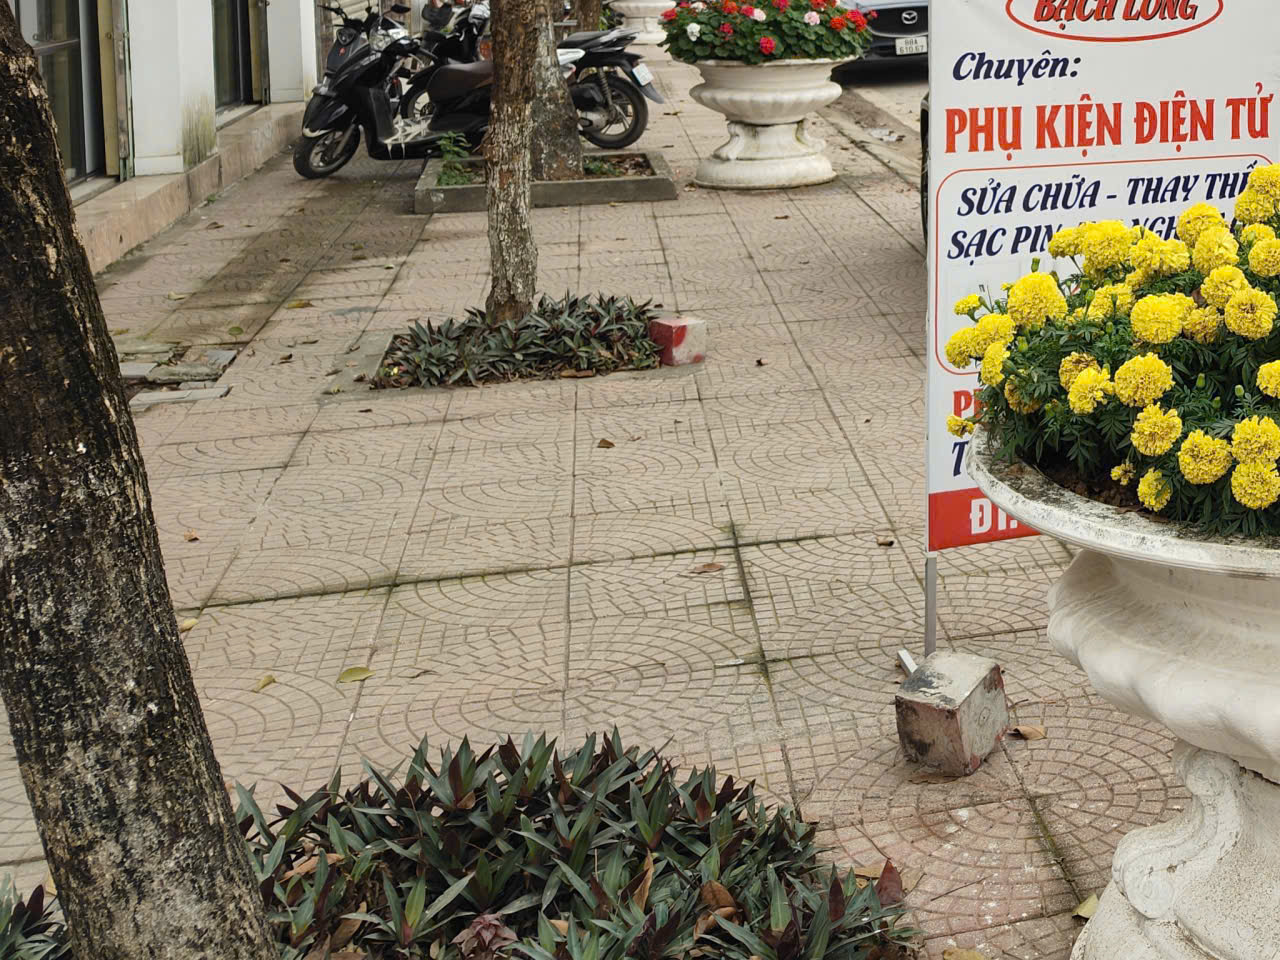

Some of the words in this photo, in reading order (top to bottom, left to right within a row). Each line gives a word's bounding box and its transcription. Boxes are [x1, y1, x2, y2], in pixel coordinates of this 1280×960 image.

[952, 50, 1082, 86] Chuyên:
[944, 106, 1023, 161] PHỤ
[1035, 93, 1122, 157] KIỆN
[1134, 89, 1215, 153] ĐIỆN
[1226, 82, 1275, 140] TỬ
[957, 177, 1017, 218] SỬA
[1021, 173, 1099, 212] CHỮA
[1127, 175, 1200, 206] THAY
[946, 226, 1009, 267] SẠC
